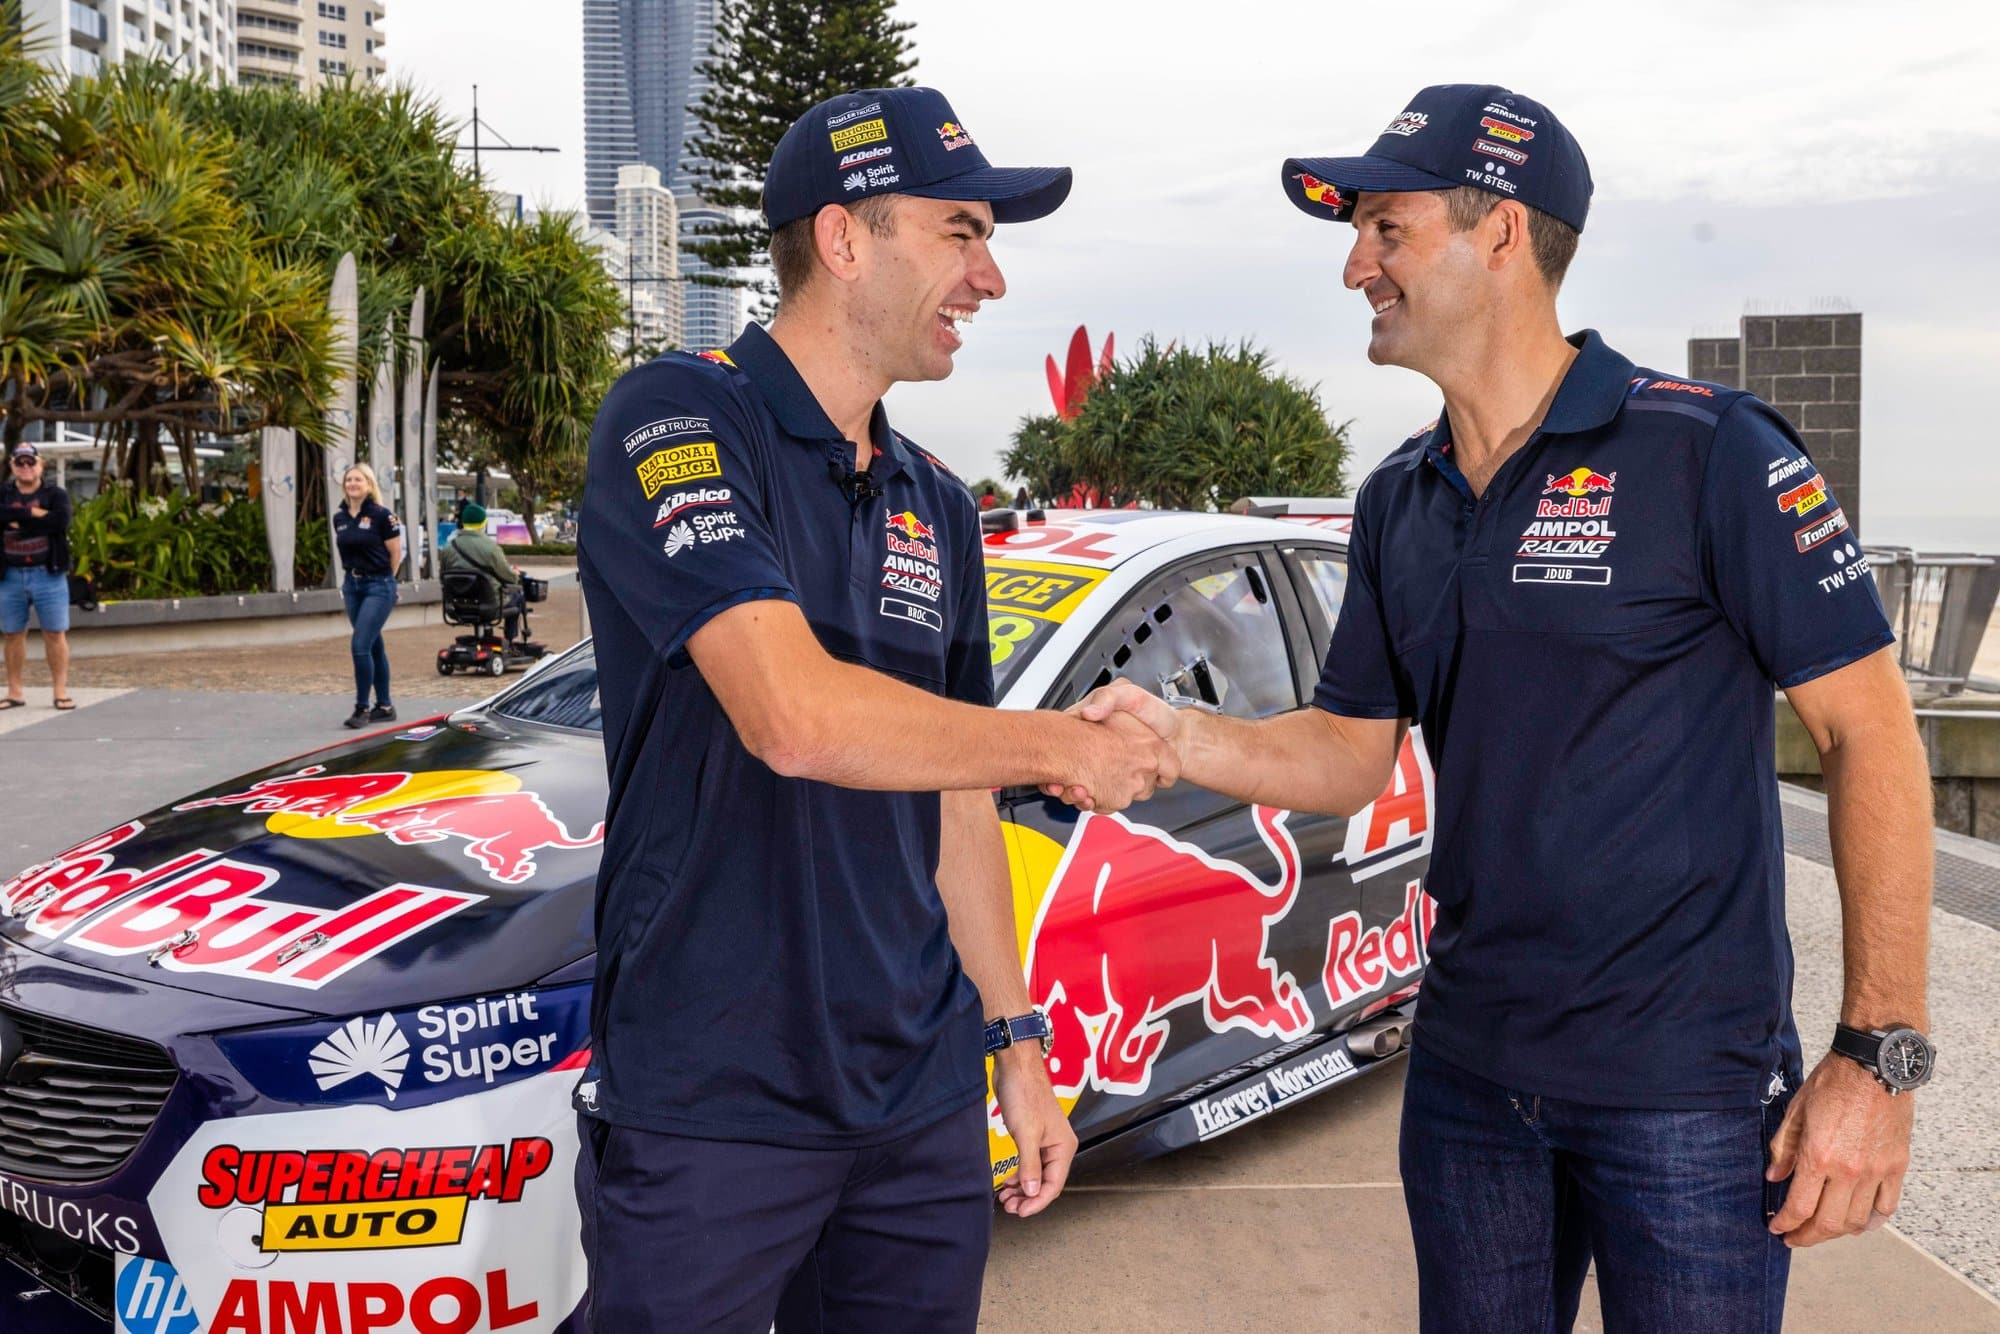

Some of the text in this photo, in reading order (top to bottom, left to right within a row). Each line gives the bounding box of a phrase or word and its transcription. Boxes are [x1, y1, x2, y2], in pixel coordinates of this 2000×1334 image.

[834, 121, 882, 140] NATIONAL
[1394, 112, 1429, 125] POL
[1493, 108, 1537, 127] AMPLIFY
[837, 128, 884, 148] STORAGE
[1494, 130, 1517, 139] AUTO
[840, 146, 893, 166] ACDelco
[1477, 142, 1522, 162] ToolPRO
[866, 164, 895, 178] Spirit
[869, 175, 900, 187] Super
[1466, 169, 1483, 181] TW
[1648, 381, 1714, 397] AMPOL
[625, 419, 709, 453] DAIMLER TRUCKS
[639, 446, 713, 479] NATIONAL
[647, 460, 713, 491] STORAGE
[656, 488, 731, 522] ACDelco
[1536, 496, 1612, 518] Red Bull
[1801, 495, 1823, 510] AUT
[693, 511, 737, 530] Spirit
[1521, 520, 1616, 537] AMPOL
[1801, 513, 1844, 546] ToolPR
[887, 532, 939, 565] Red Bull
[984, 527, 1118, 561] OL
[1517, 540, 1611, 554] RACING
[883, 554, 943, 585] AMPOL
[1544, 568, 1573, 580] JDUB
[1818, 556, 1871, 593] TW STE
[882, 571, 940, 598] RACING
[907, 606, 927, 622] BROC
[0, 821, 485, 988] Red Bull
[417, 993, 539, 1047] Spirit
[423, 1032, 556, 1086] Super
[1190, 1081, 1272, 1137] Harvey
[1267, 1048, 1354, 1099] Norman
[198, 1137, 553, 1209] SUPERCHEAP
[0, 1176, 141, 1255] TRUCKS
[284, 1207, 438, 1241] AUTO
[125, 1256, 193, 1334] hp
[208, 1268, 540, 1334] AMPOL
